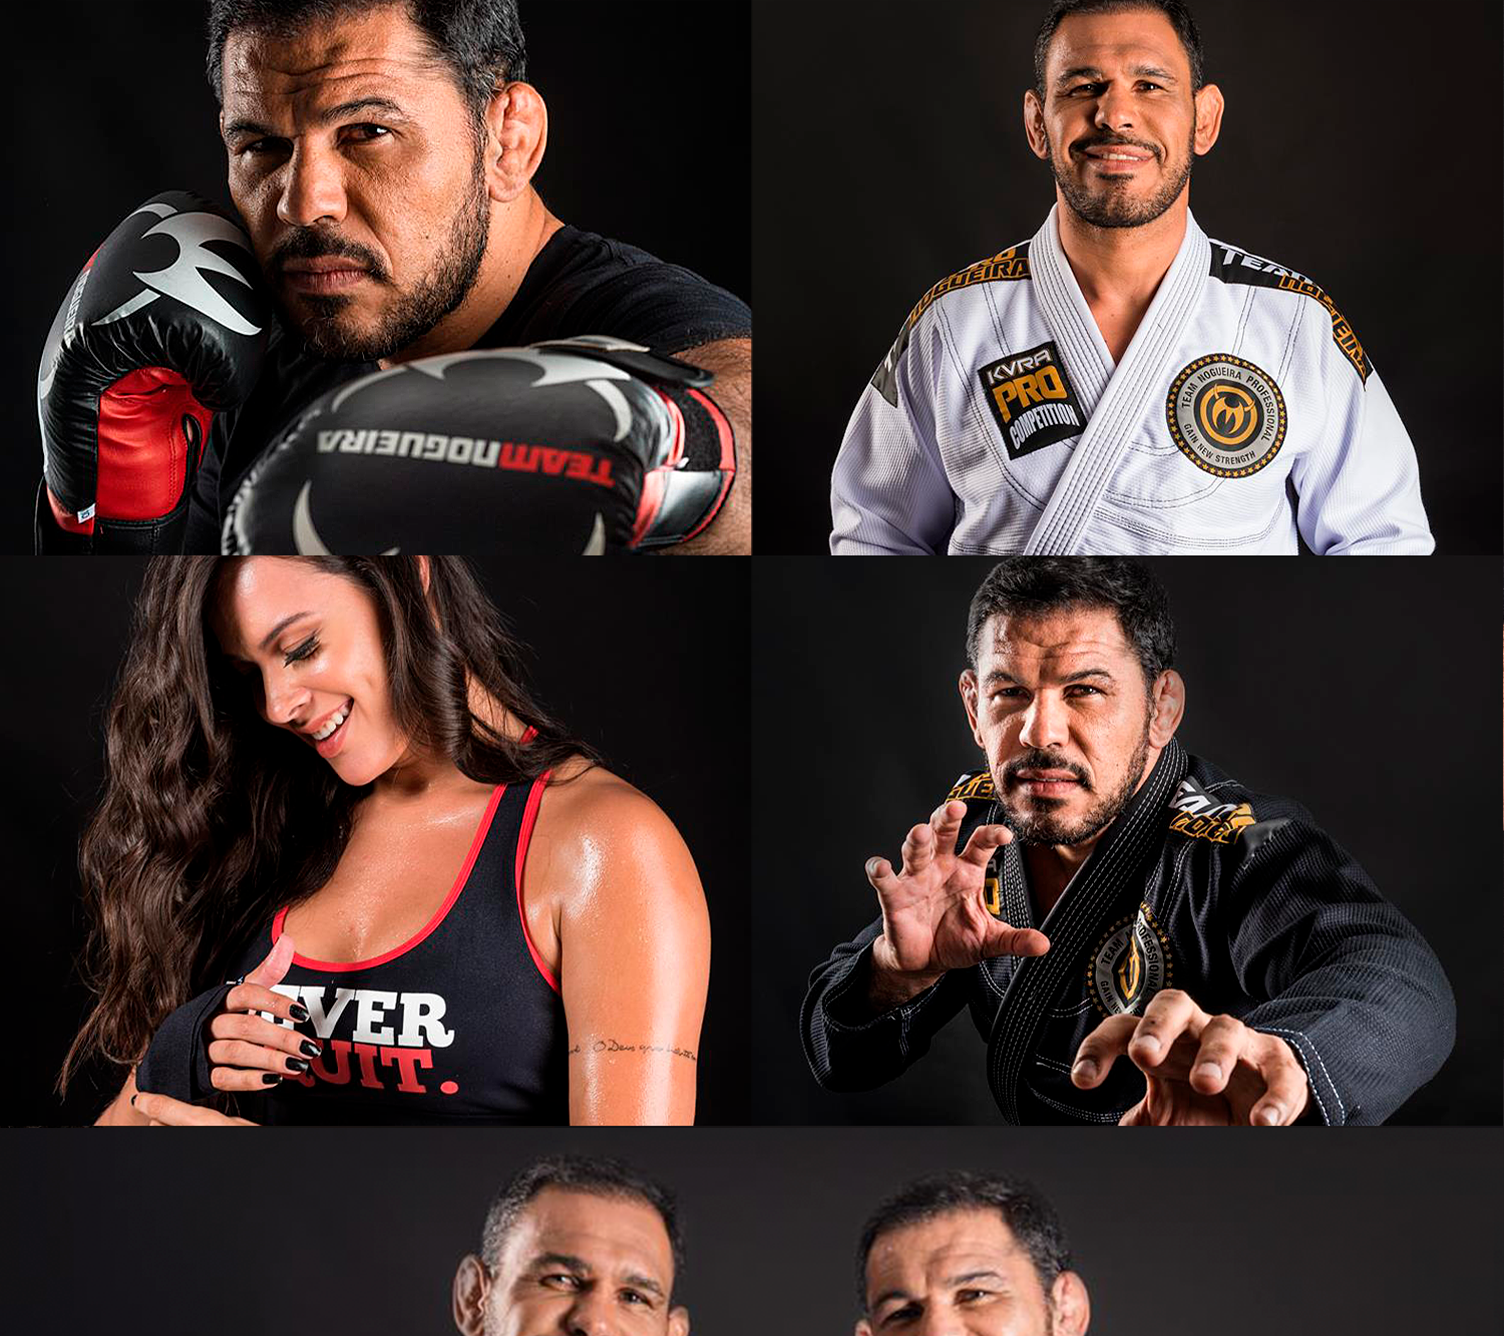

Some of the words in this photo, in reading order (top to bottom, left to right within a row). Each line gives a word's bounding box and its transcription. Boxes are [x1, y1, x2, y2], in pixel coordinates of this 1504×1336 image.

[987, 349, 1053, 385] KVRA
[992, 364, 1068, 424] PRO
[1182, 382, 1198, 408] TEAM
[1197, 366, 1242, 383] NOGUEIRA
[1246, 375, 1275, 441] PROFESSIONAL
[1009, 402, 1080, 450] COMPETITION
[1183, 423, 1198, 443] GAIN
[1197, 443, 1214, 459] NEW
[1214, 450, 1256, 465] STRENGTH
[1101, 938, 1124, 965] TEAM
[1138, 919, 1159, 993] OFESSIONAL
[249, 984, 455, 1048] VER
[1100, 980, 1114, 1002] GAIN
[1110, 1002, 1122, 1014] NE
[283, 1038, 459, 1095] UIT.
